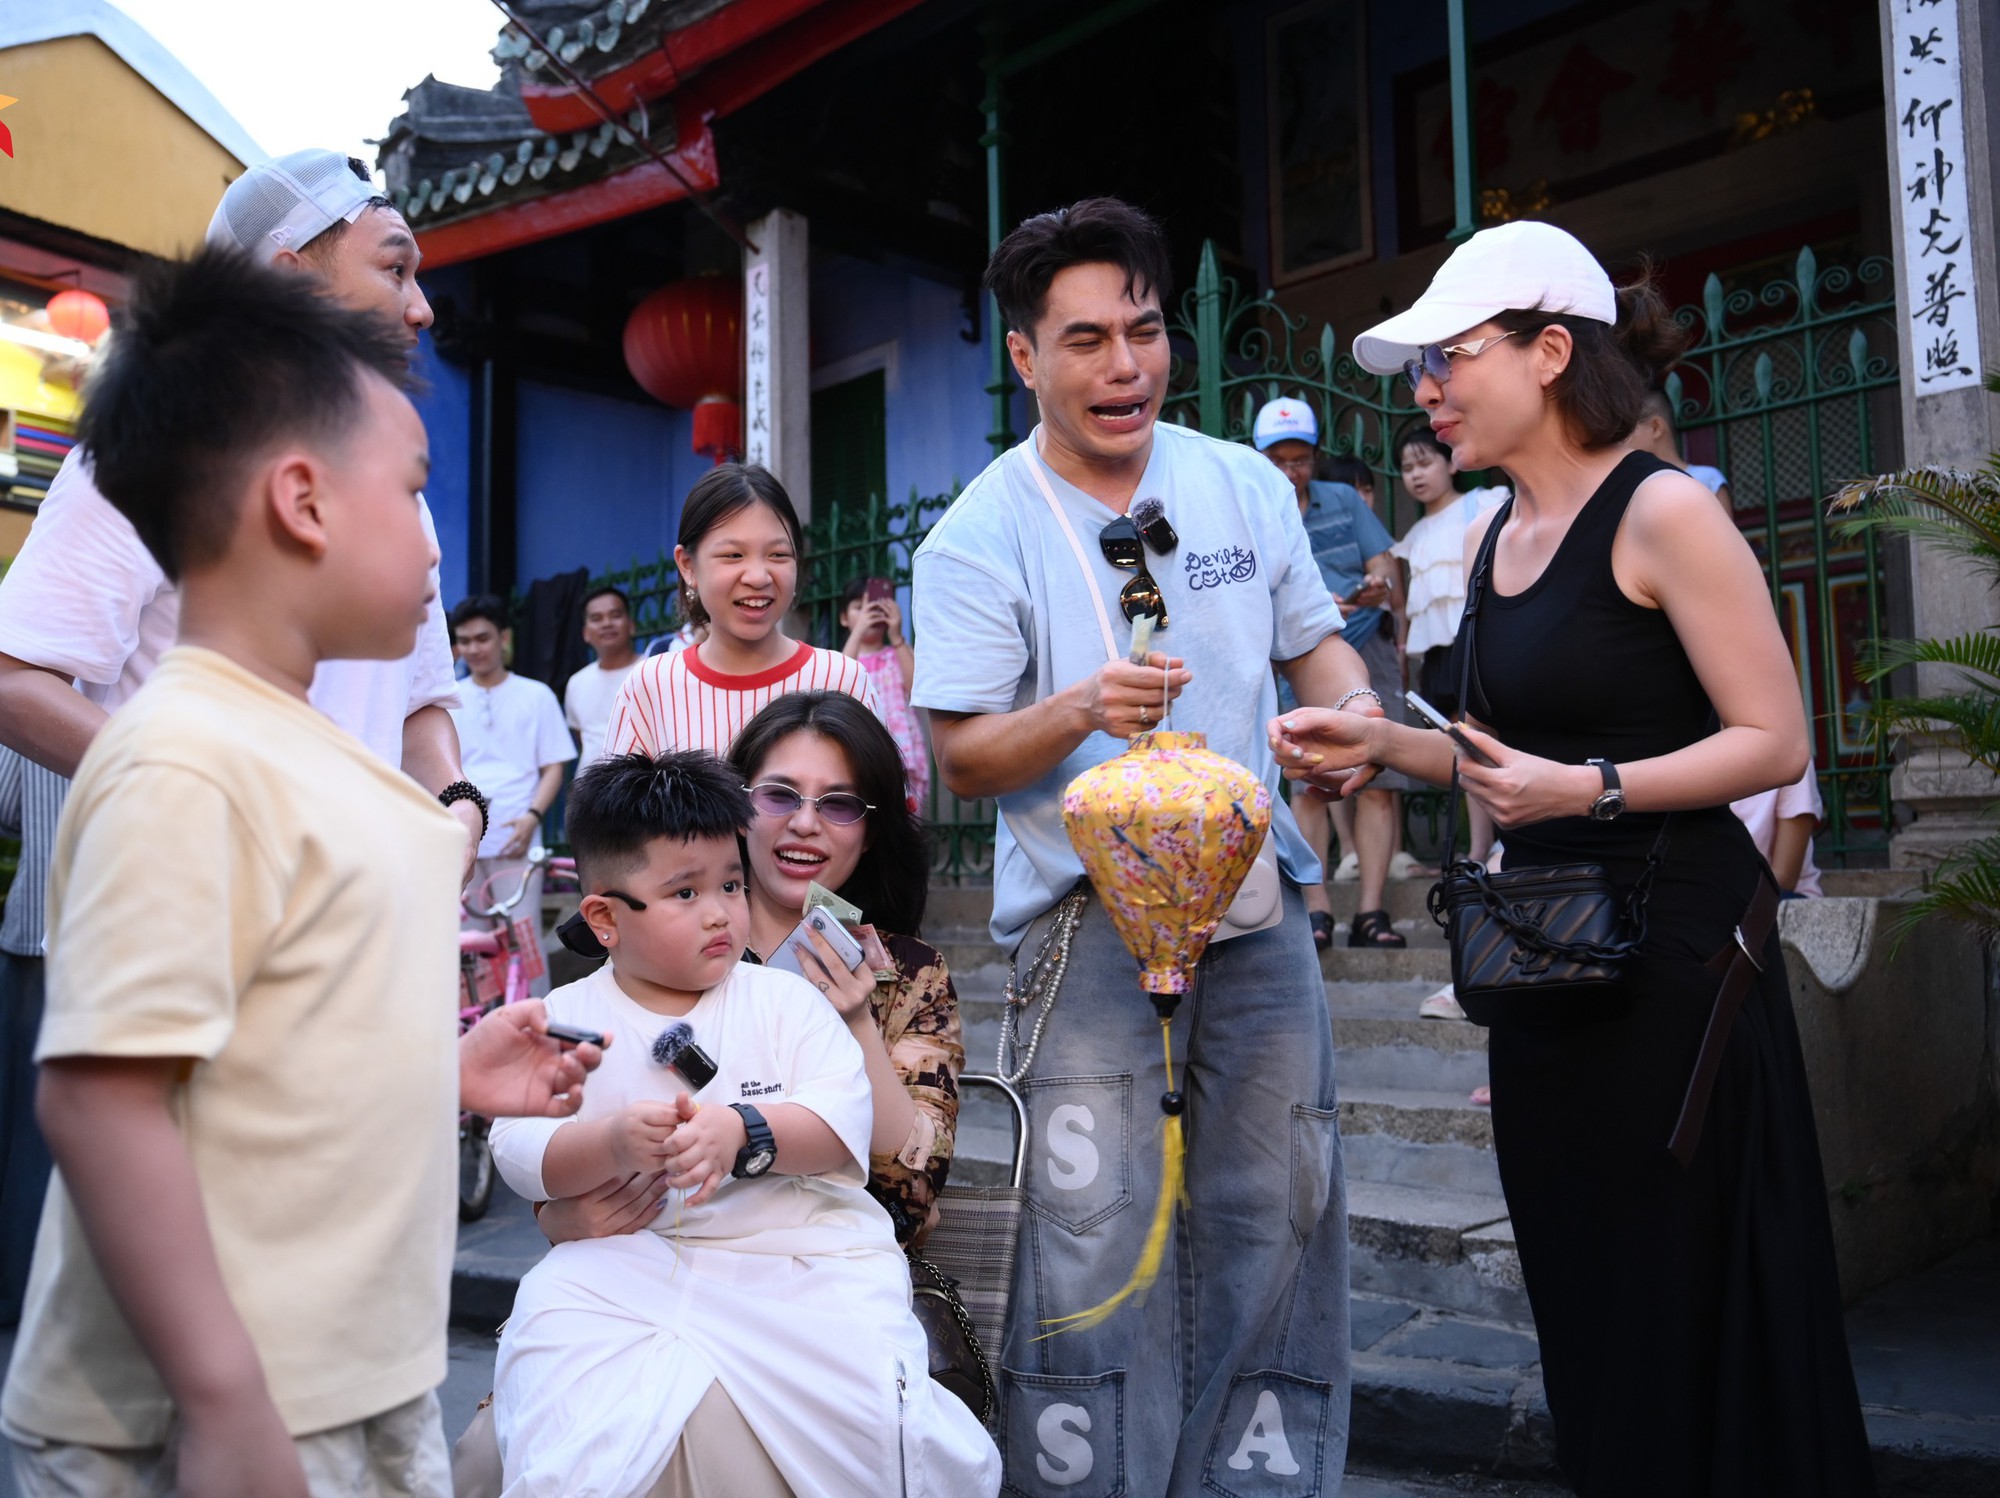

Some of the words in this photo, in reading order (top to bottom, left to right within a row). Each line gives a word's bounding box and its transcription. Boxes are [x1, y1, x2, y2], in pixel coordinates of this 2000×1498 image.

[1902, 0, 1973, 383] 共仰神光普照
[741, 1088, 763, 1097] basic
[764, 1083, 785, 1094] stuff.
[1047, 1104, 1099, 1190] S
[1036, 1402, 1093, 1485] S
[1228, 1390, 1300, 1475] A
